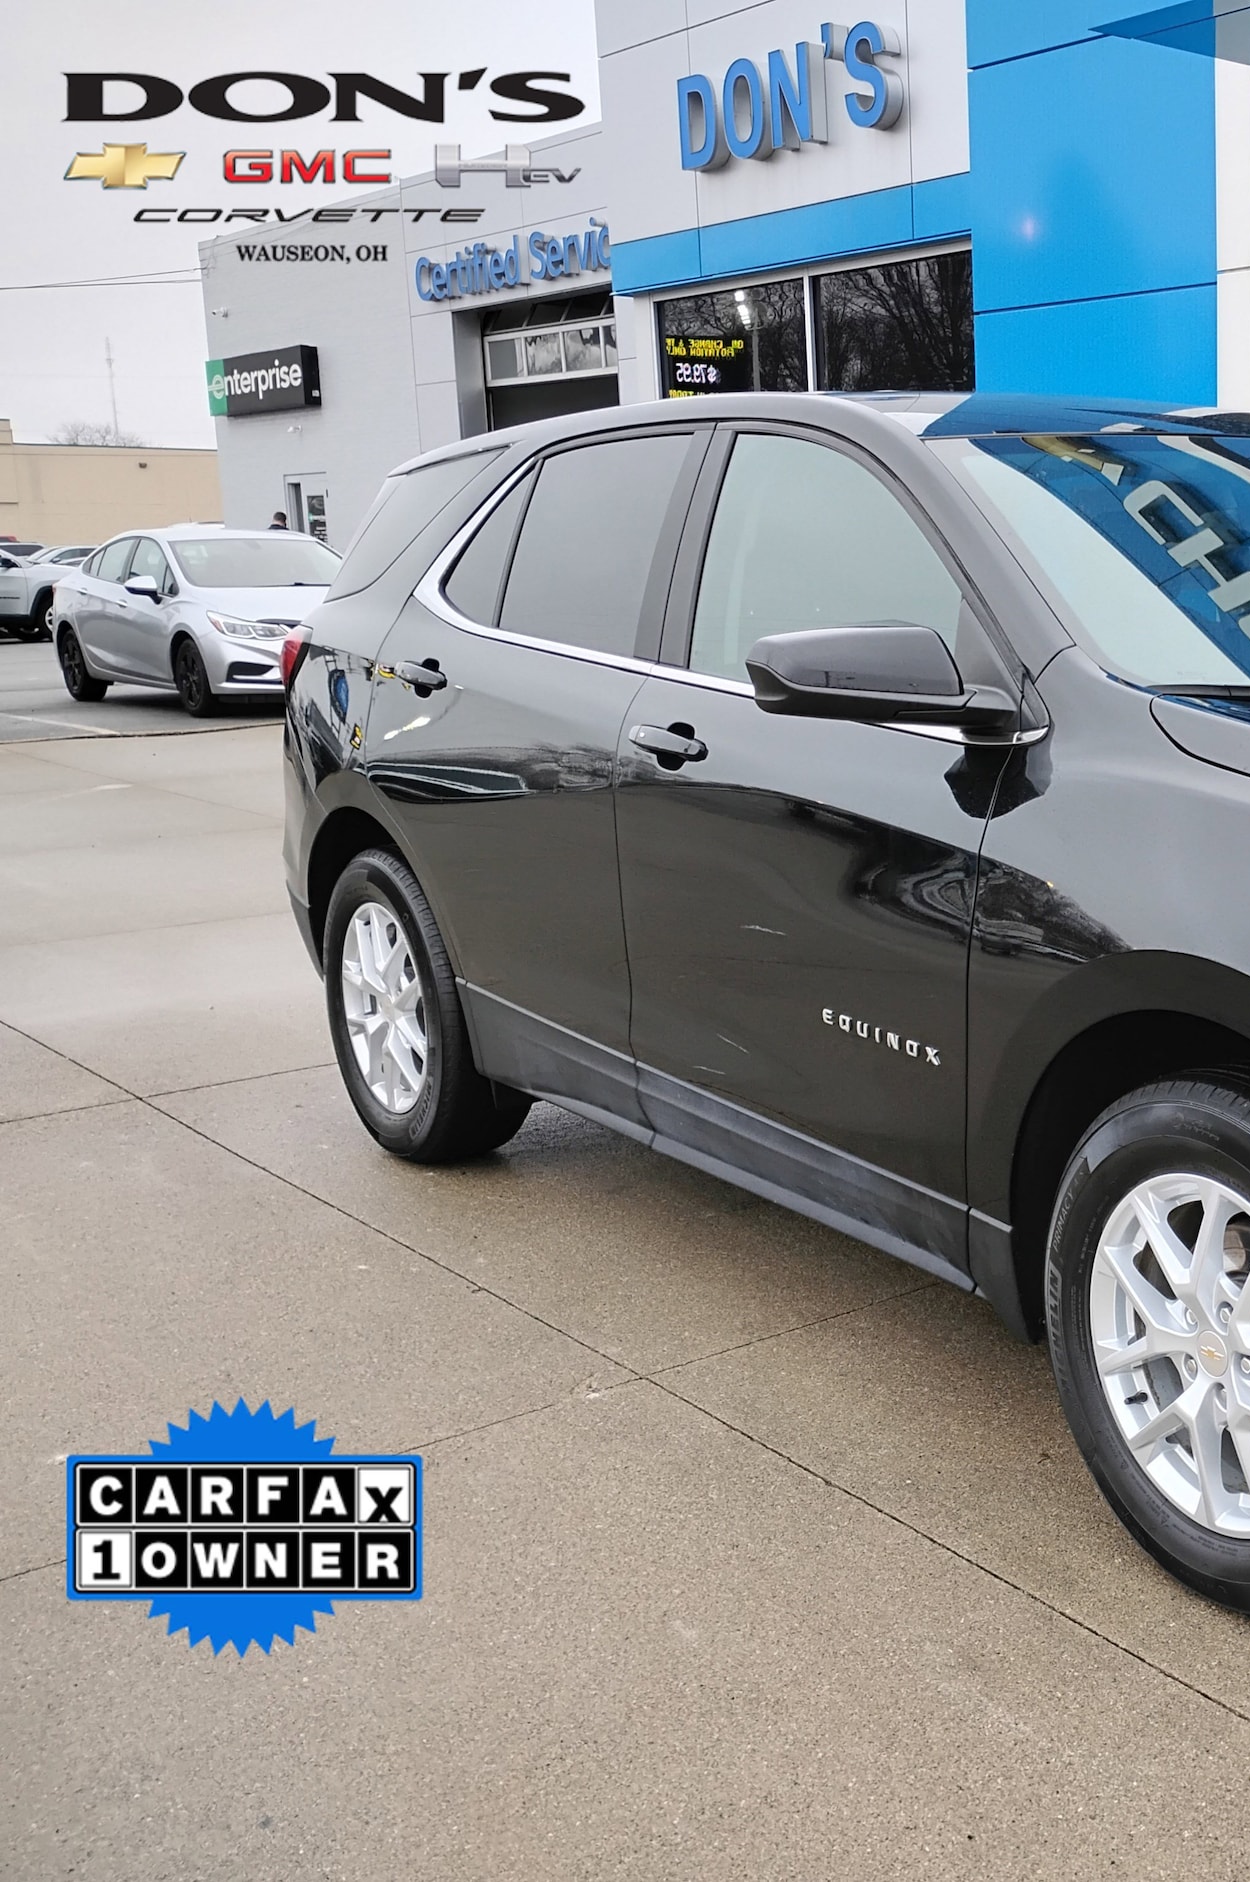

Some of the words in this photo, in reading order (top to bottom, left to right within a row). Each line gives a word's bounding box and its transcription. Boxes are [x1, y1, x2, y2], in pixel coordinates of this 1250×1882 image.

[676, 20, 901, 171] DON'S
[415, 235, 523, 301] Certified
[208, 358, 303, 400] enterprise
[821, 1008, 942, 1066] EQUINOX
